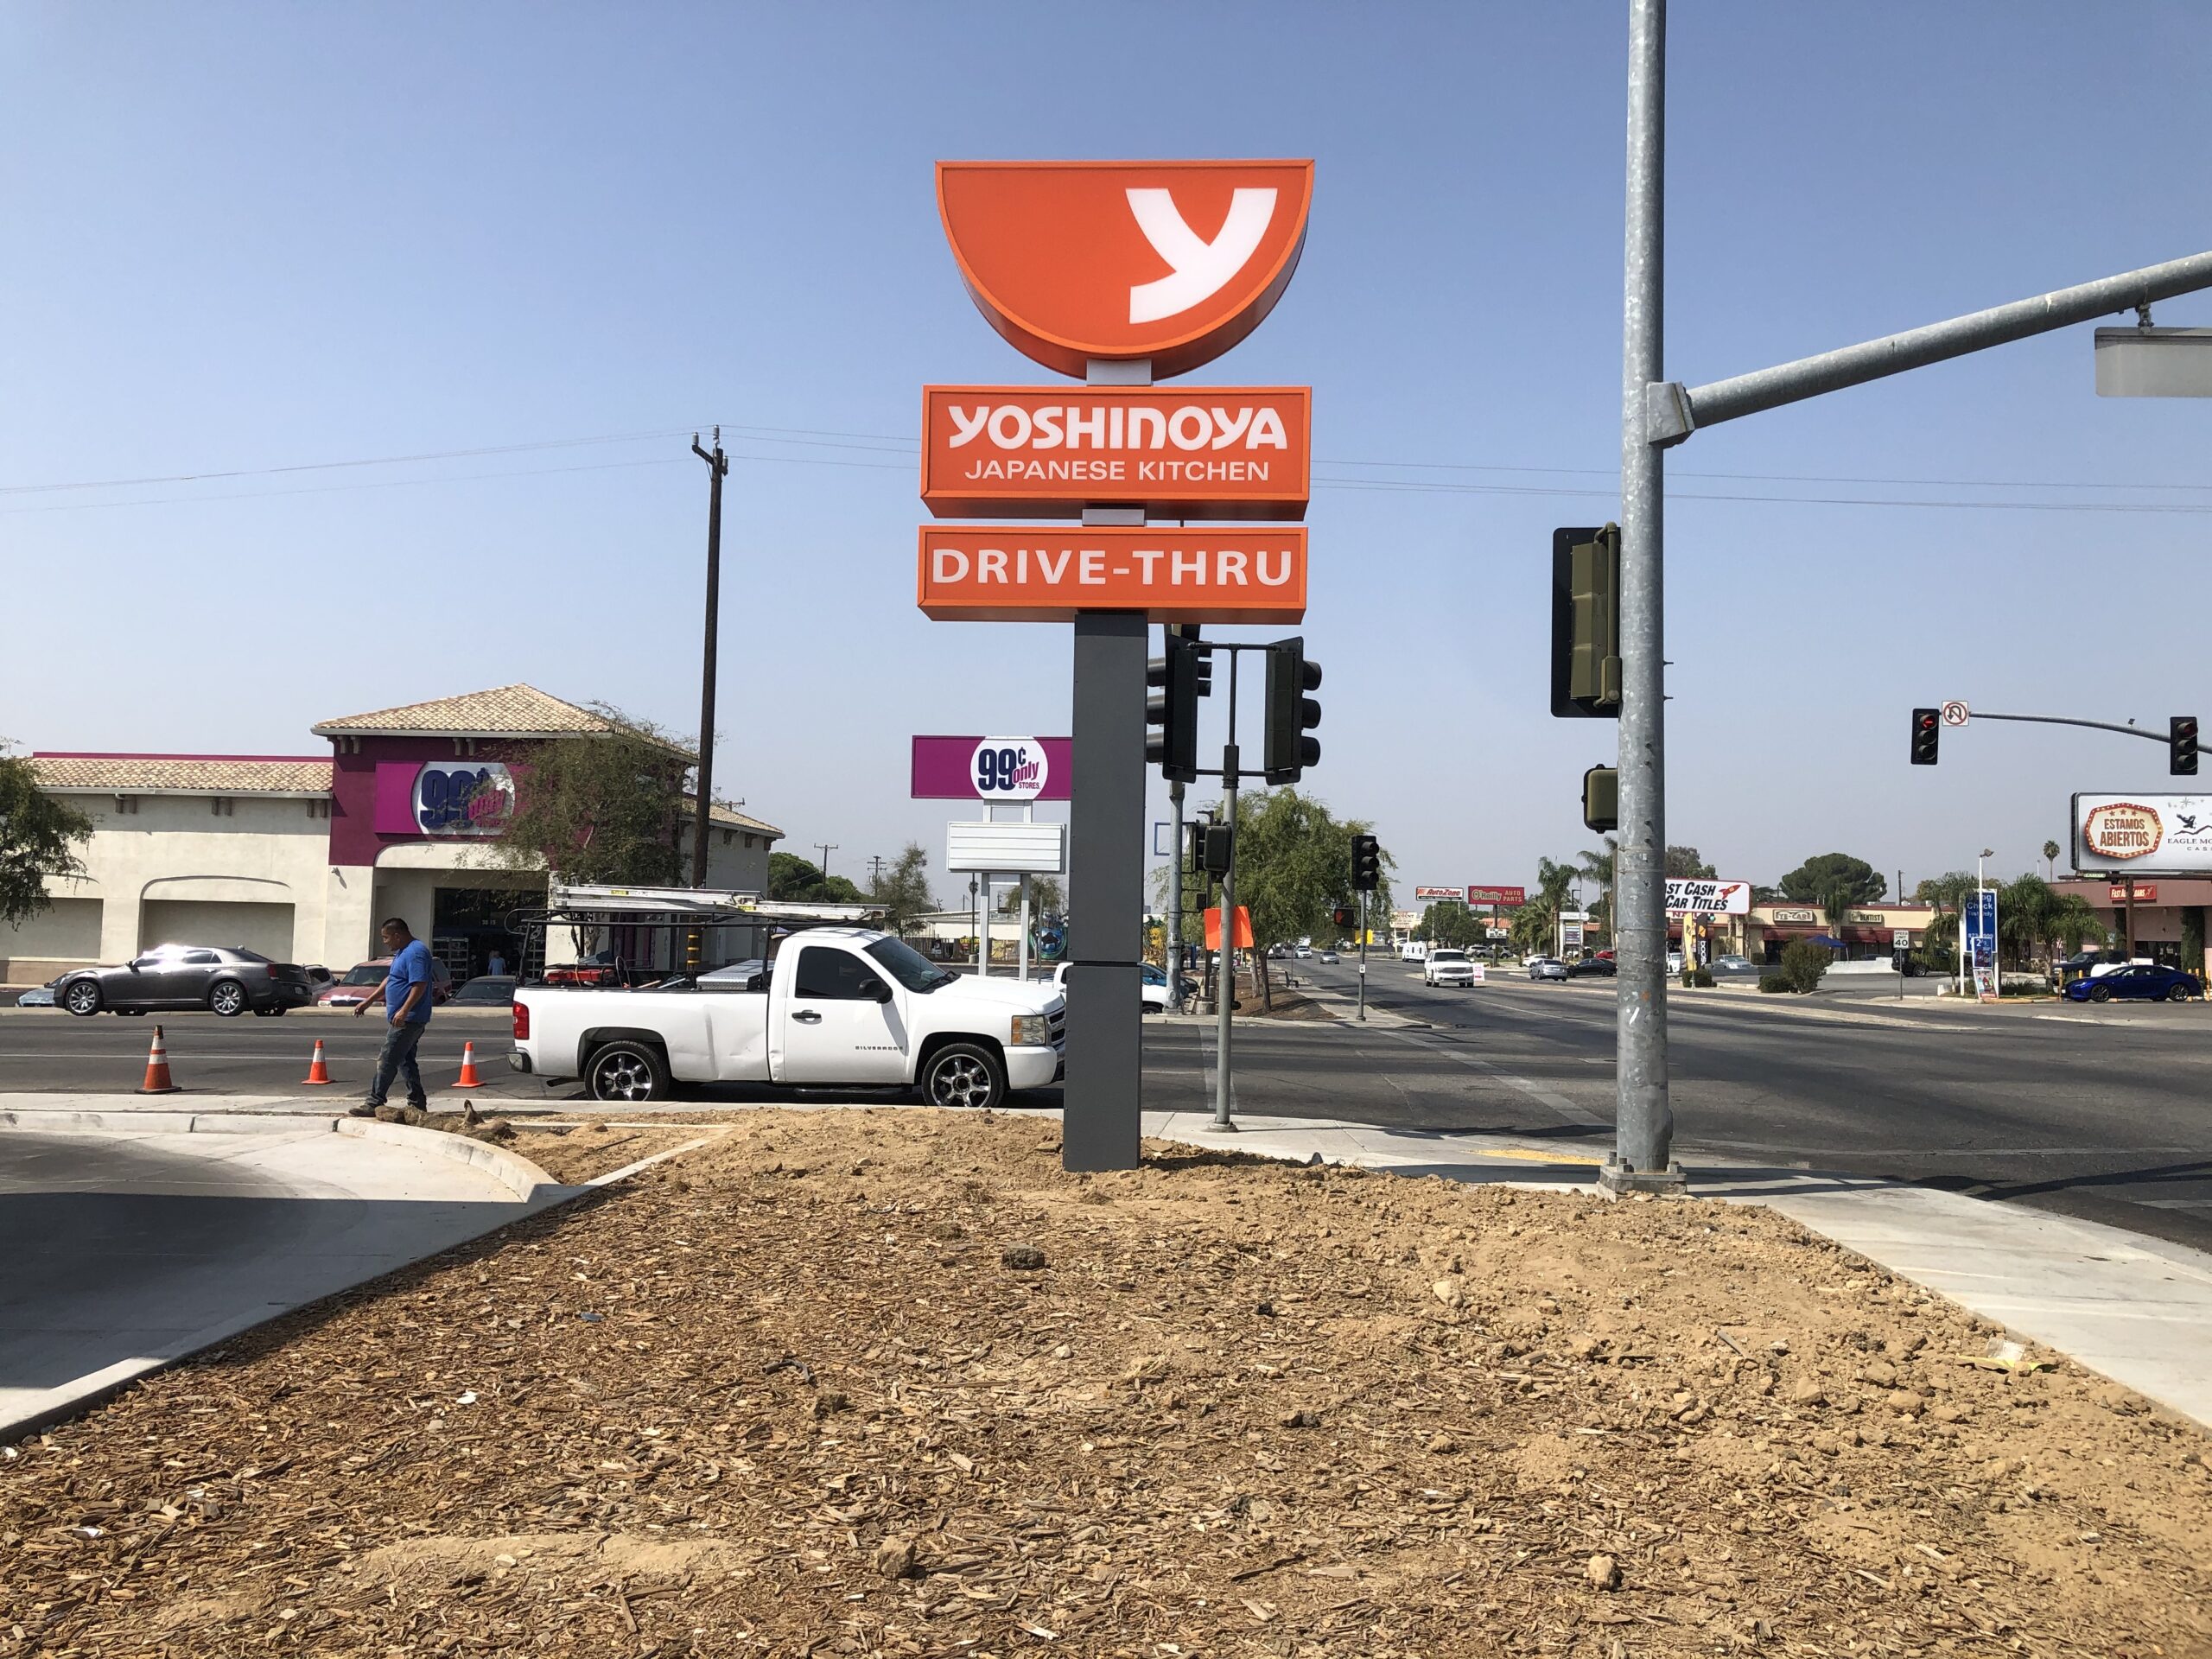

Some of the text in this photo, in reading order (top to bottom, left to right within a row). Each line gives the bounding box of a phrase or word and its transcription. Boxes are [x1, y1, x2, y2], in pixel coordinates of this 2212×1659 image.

[948, 404, 1287, 450] YOSHINOYA
[964, 460, 1269, 481] JAPANESE KITCHEN
[932, 549, 1293, 586] DRIVE-THRU
[2104, 818, 2145, 830] ESTAMOS
[2100, 831, 2150, 847] ABIERTOS
[1427, 888, 1461, 897] AutoZone
[1684, 881, 1717, 896] CASH
[1691, 895, 1728, 911] TITLES
